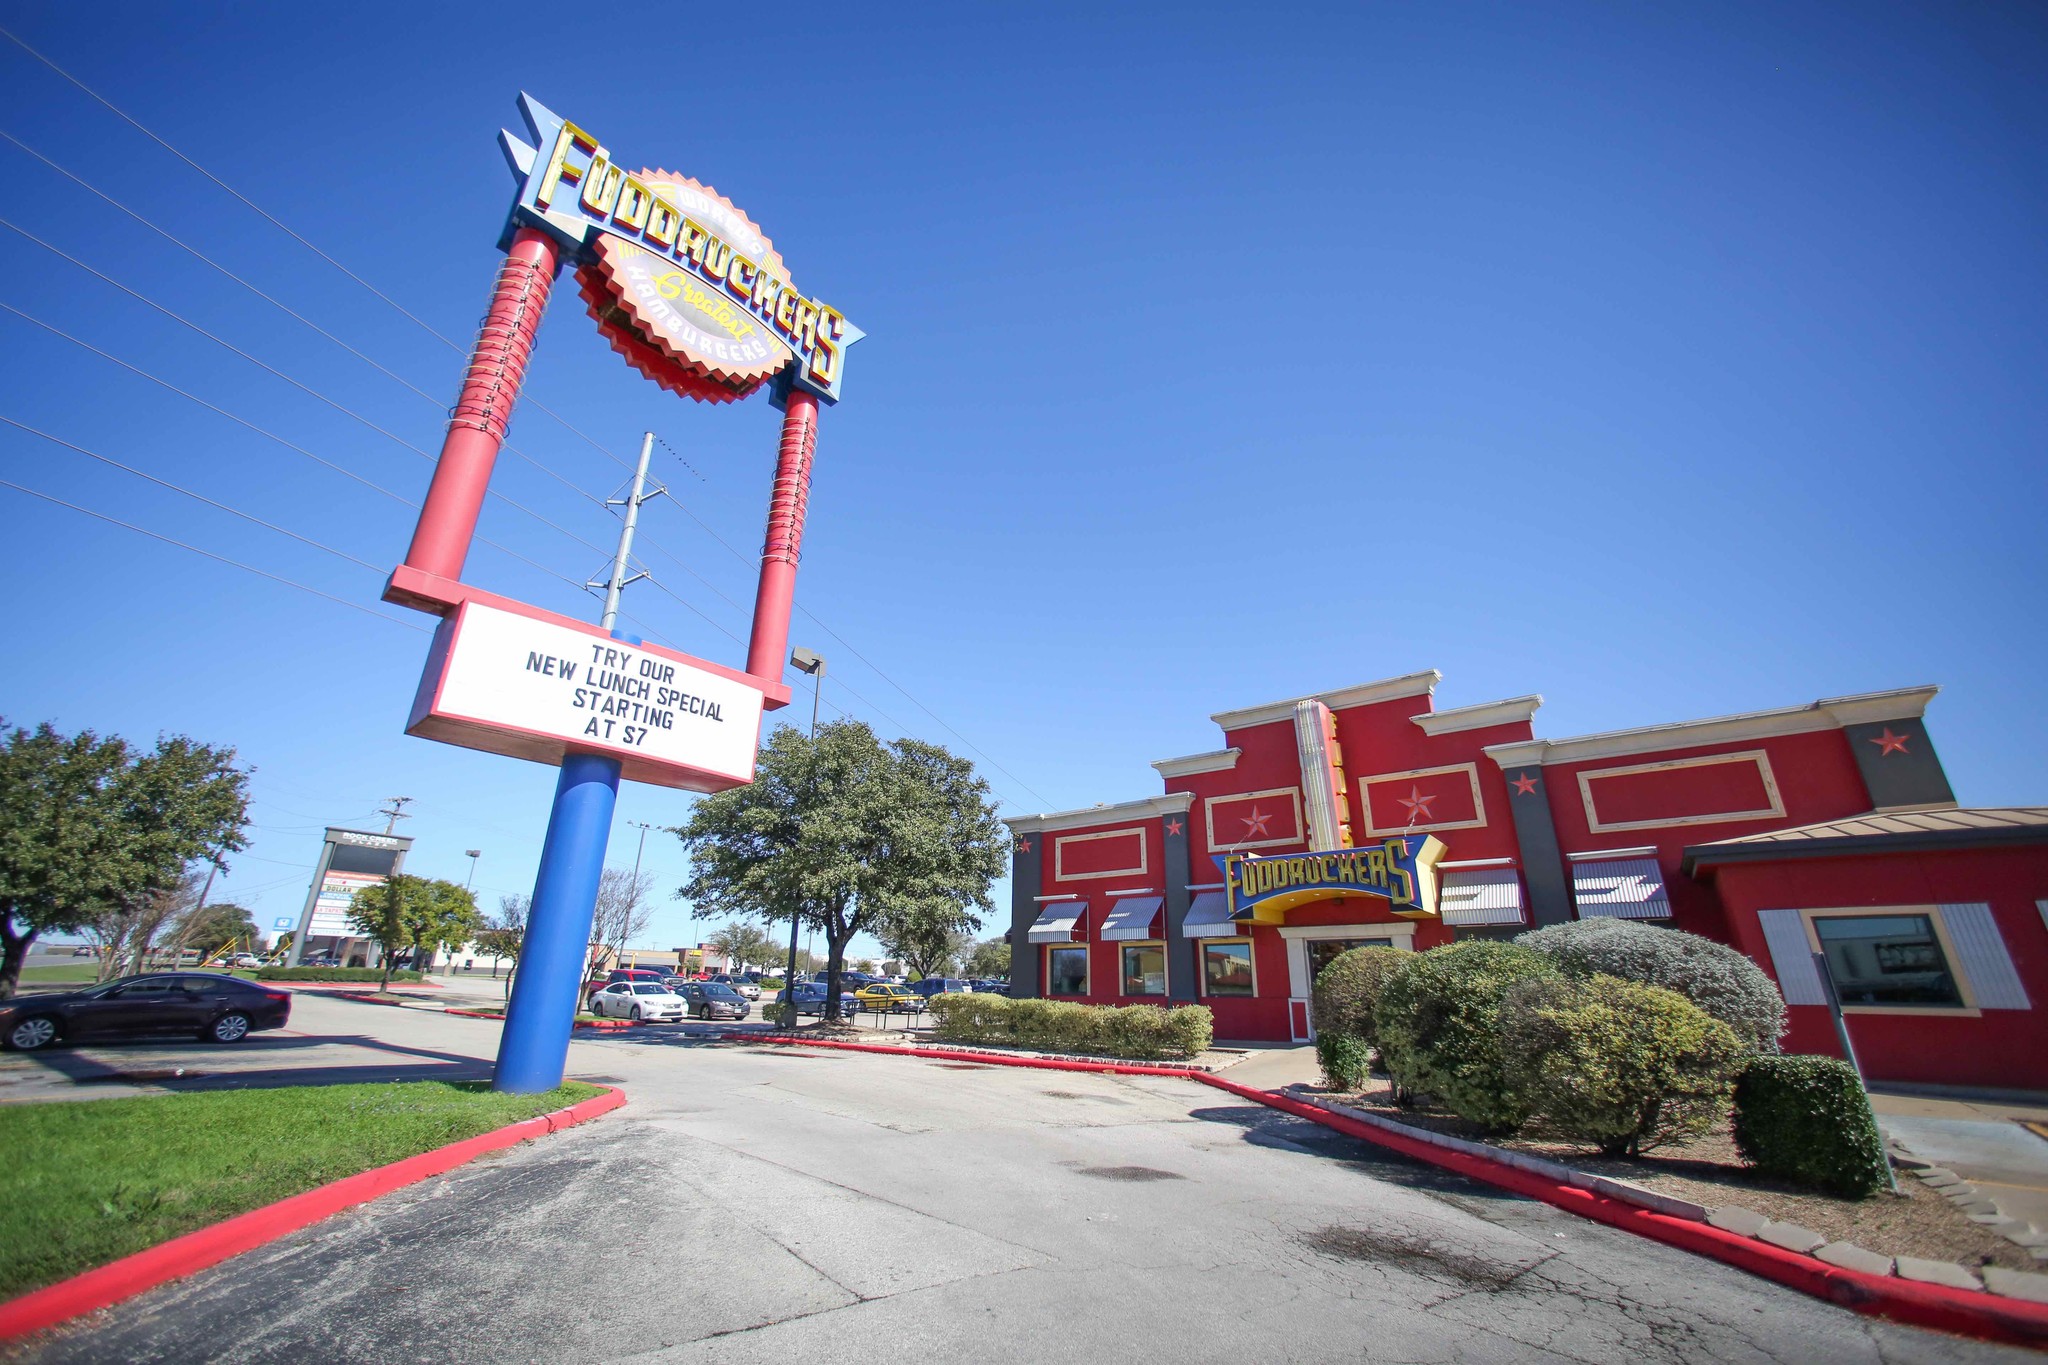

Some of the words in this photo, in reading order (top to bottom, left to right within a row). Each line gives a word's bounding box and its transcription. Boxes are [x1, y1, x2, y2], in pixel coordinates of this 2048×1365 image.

[536, 118, 844, 387] FUDDRUCKERS
[679, 189, 765, 256] WORLD'S
[626, 265, 768, 363] HAMBURGERS
[650, 271, 757, 344] Greatest
[525, 651, 578, 681] NEW
[586, 667, 650, 700] LUNCH
[657, 687, 724, 722] SPECIAL
[592, 644, 632, 671] TRY
[639, 658, 675, 685] OUR
[572, 688, 674, 730] STARTING
[584, 717, 617, 738] AT
[342, 832, 369, 841] ROCK
[370, 835, 399, 844] CREEK
[326, 885, 352, 893] DOLLAR
[1225, 839, 1416, 914] FUDDRUCKERS
